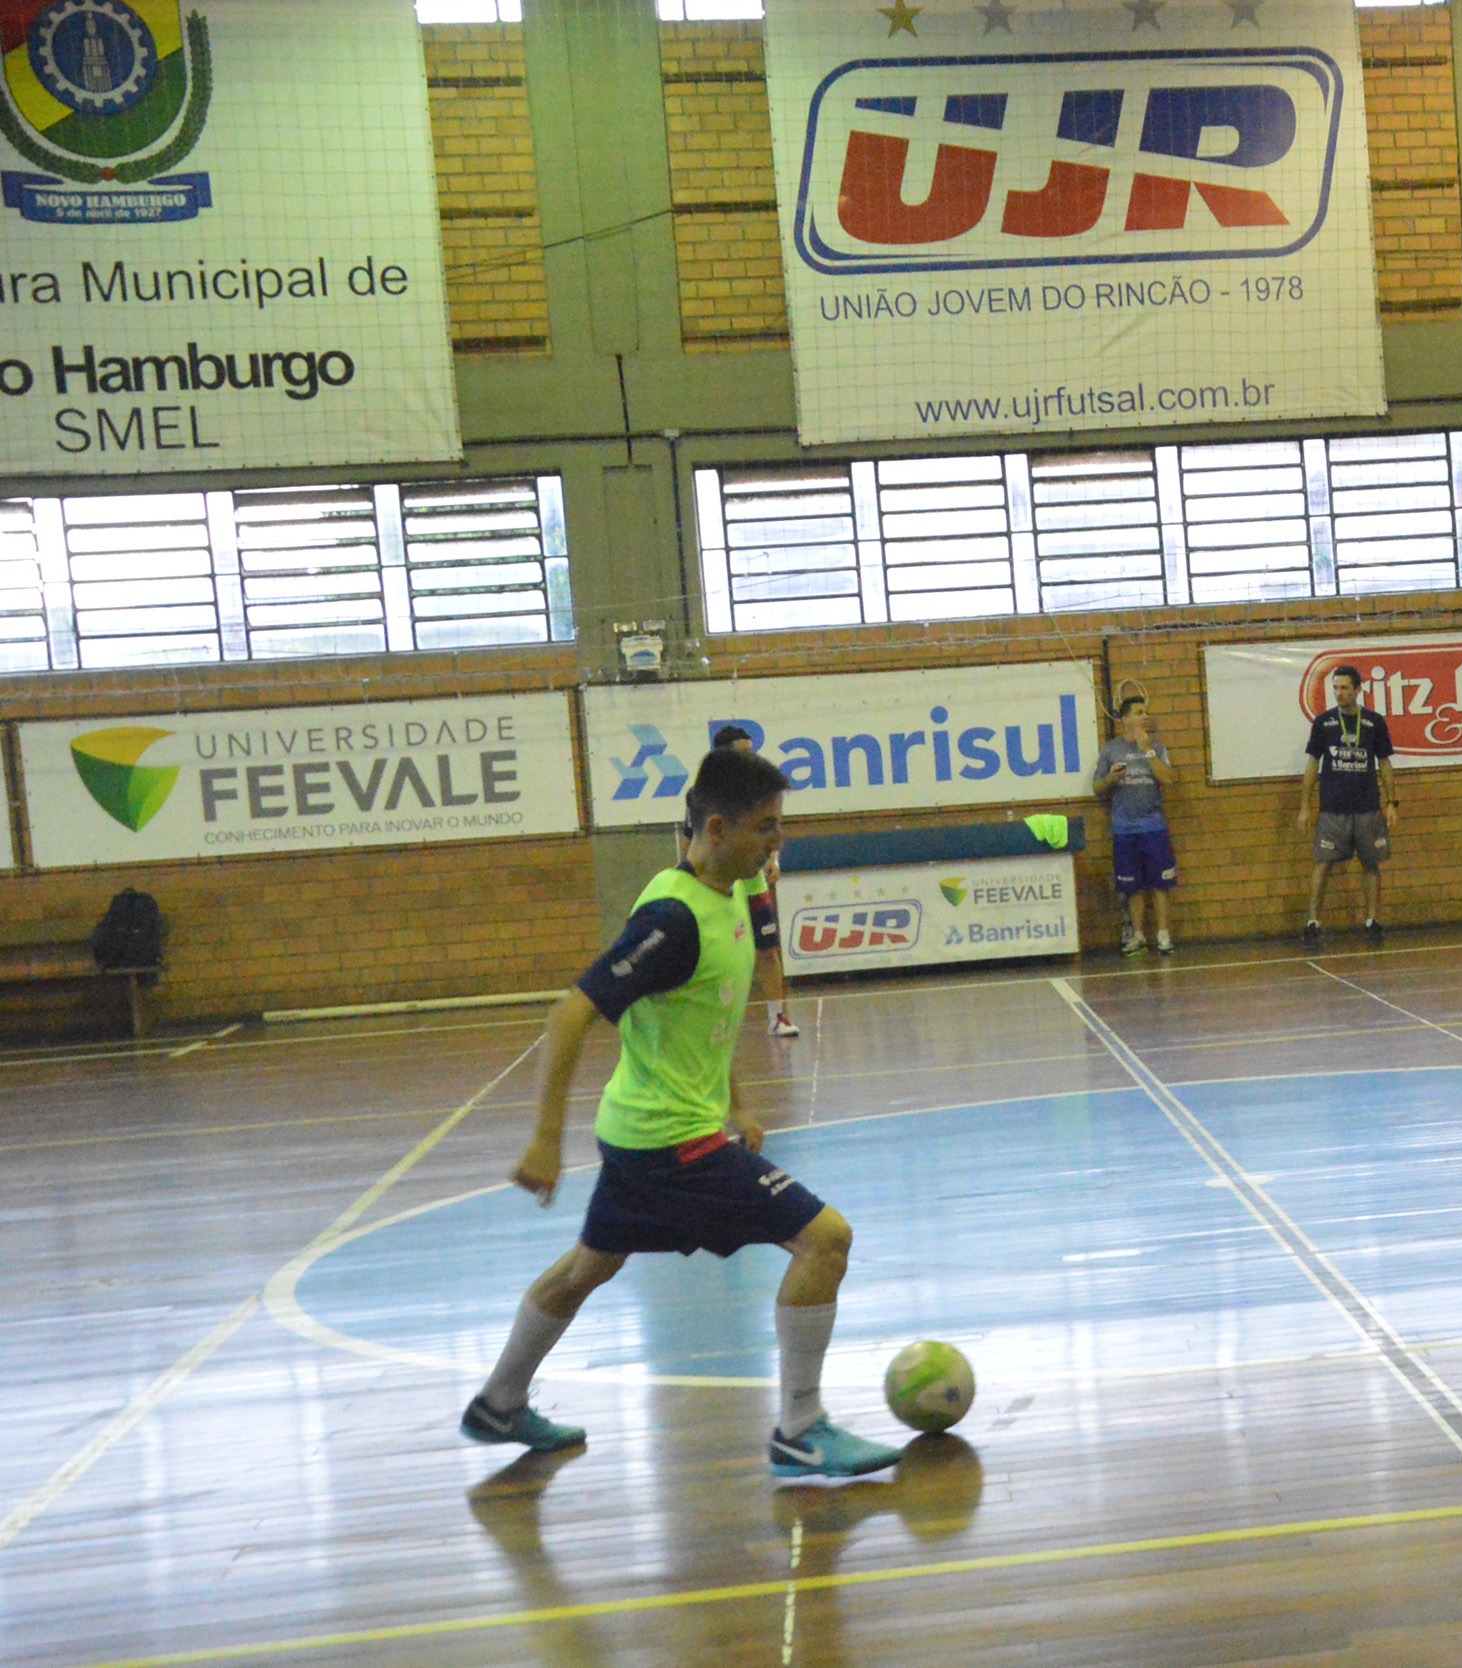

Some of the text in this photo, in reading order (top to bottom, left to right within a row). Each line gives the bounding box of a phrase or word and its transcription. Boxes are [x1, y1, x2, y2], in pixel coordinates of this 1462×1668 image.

[837, 84, 1297, 245] UJR
[35, 193, 187, 208] NOVO HAMBURGO
[0, 256, 408, 309] ra Municipal de
[820, 289, 917, 322] UNIÃO
[928, 287, 1032, 318] JOVEM
[1041, 284, 1086, 313] DO
[1240, 275, 1304, 302] 1978
[51, 342, 355, 400] Hamburgo
[915, 378, 1275, 425] www.ujrfutsal.com.br
[55, 405, 220, 454] SMEL
[195, 716, 516, 759] UNIVERSIDADE
[200, 750, 521, 822] FEEVALE
[204, 811, 523, 845] CONHECIMENTO PARA INOVAR O MUNDO
[973, 883, 1063, 904] FEEVALE
[799, 908, 911, 952] UJR
[969, 916, 1066, 943] Banrisul
